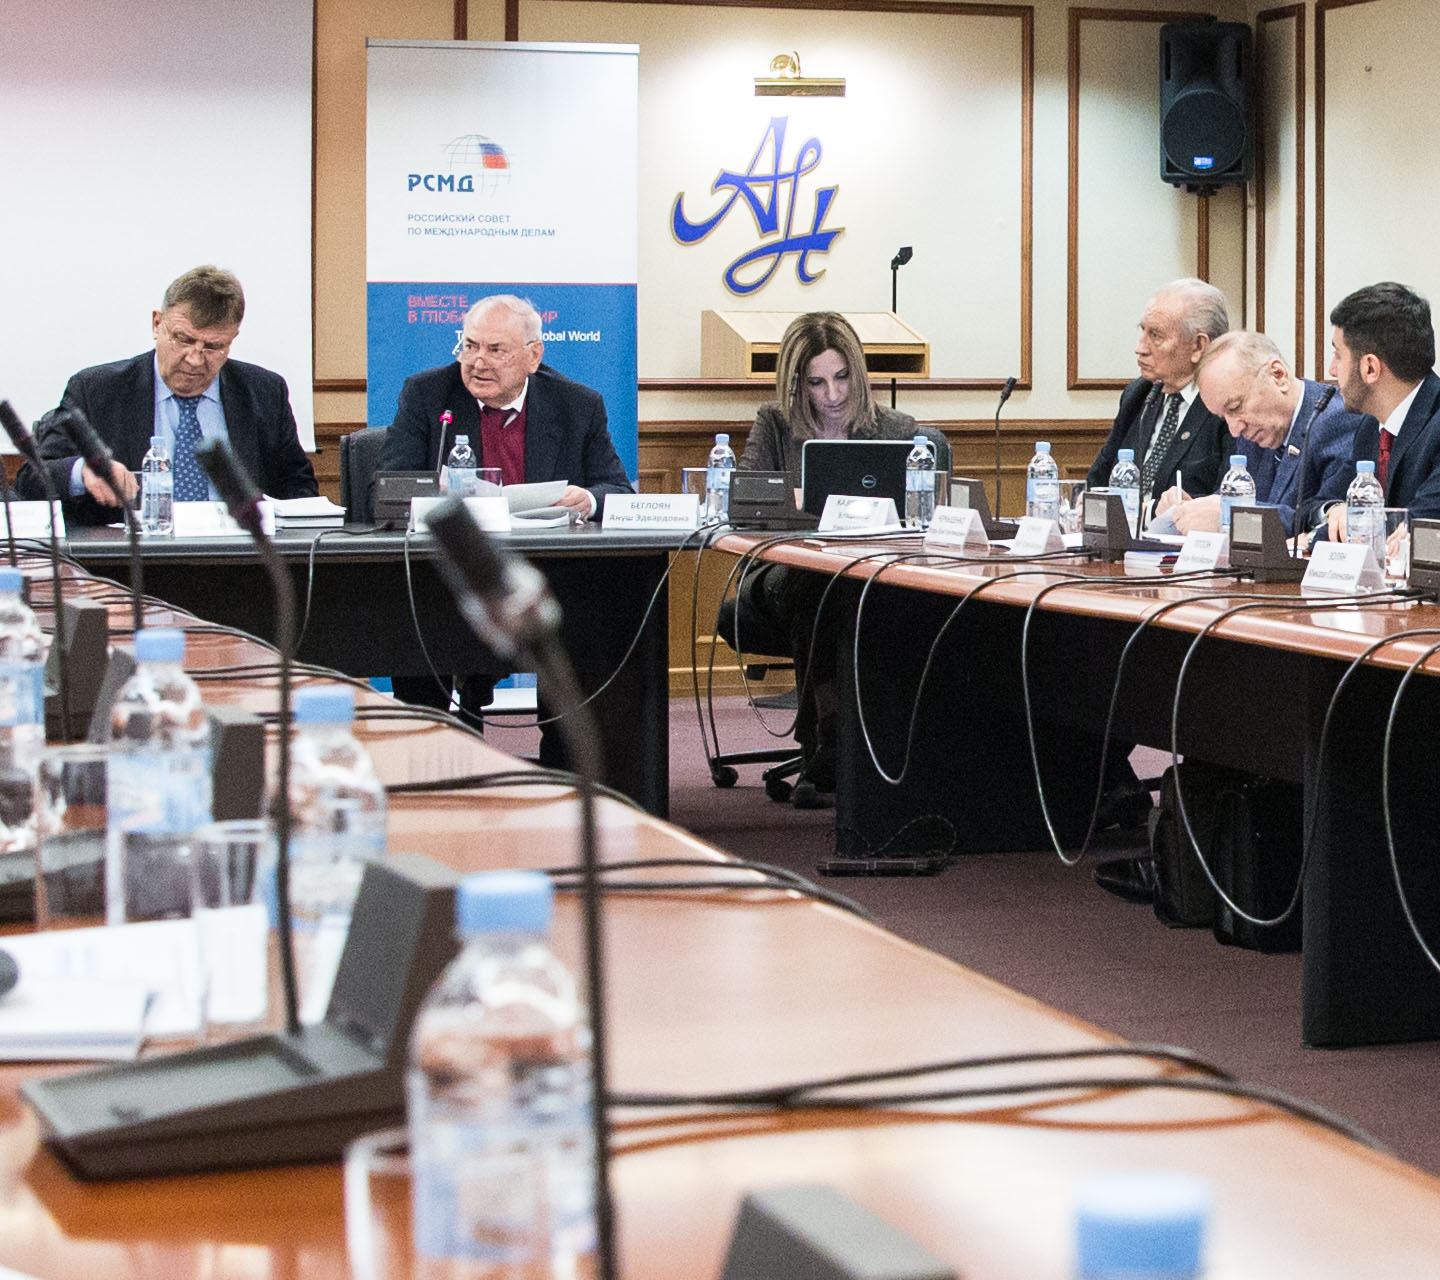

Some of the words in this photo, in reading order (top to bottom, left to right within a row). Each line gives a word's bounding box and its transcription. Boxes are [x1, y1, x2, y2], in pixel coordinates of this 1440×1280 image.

[408, 175, 475, 192] РСМД
[407, 213, 475, 223] РОССИЙСКИЙ
[477, 214, 511, 223] СОВЕТ
[407, 227, 422, 236] ПО
[424, 228, 519, 237] МЕЖДУНАРОДНЫМ
[520, 228, 556, 238] ДЕЛАМ
[408, 295, 469, 309] ВМЕСТЕ
[408, 311, 418, 323] В
[541, 331, 566, 341] lobal
[568, 331, 601, 342] World
[630, 502, 671, 510] БЕГЛОЯН
[635, 514, 689, 523] Эдвардовна
